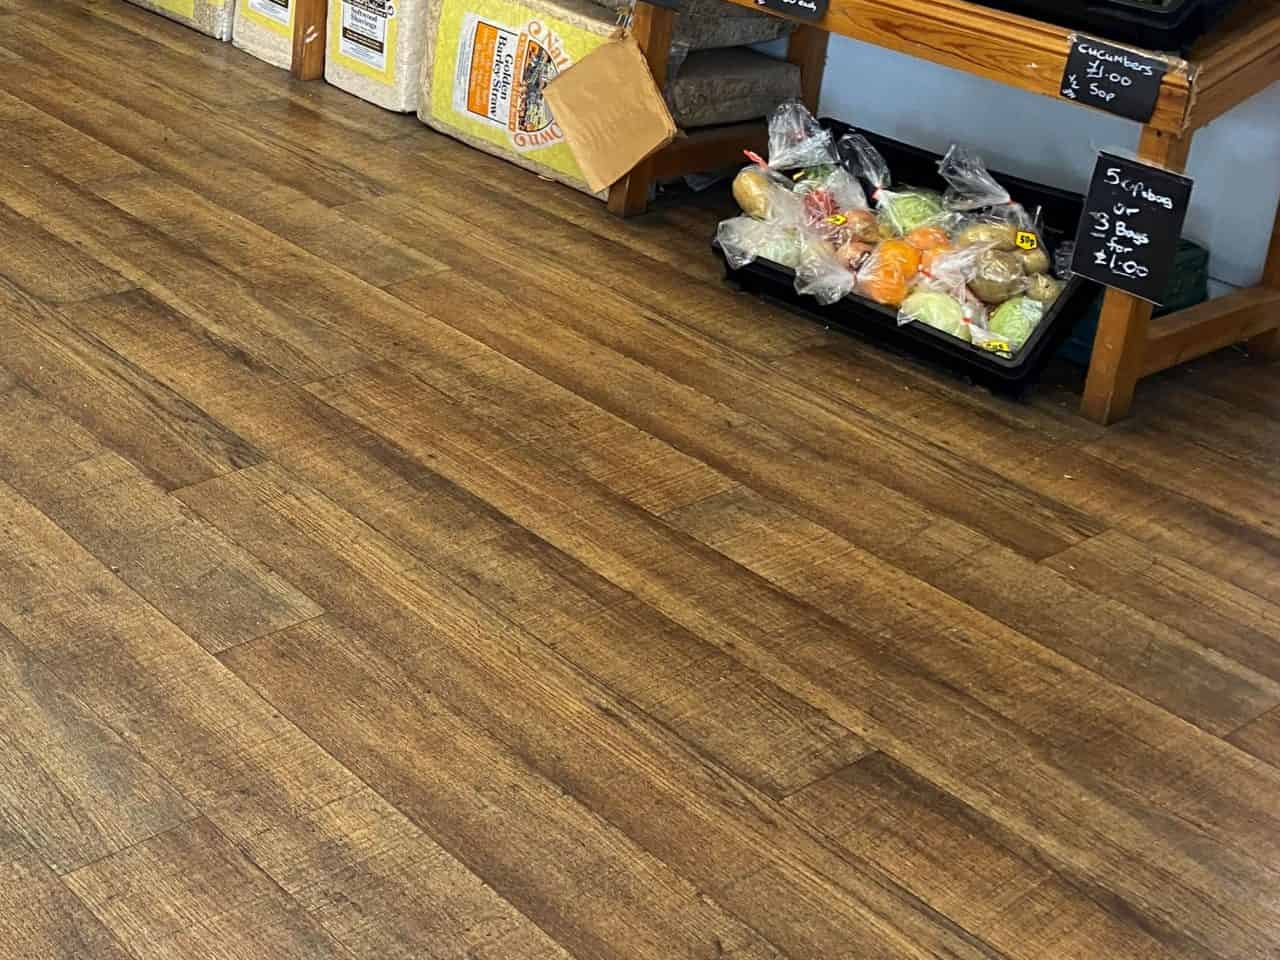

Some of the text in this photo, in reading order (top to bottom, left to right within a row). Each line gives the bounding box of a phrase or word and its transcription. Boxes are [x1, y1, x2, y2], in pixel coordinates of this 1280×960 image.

[490, 36, 507, 117] Barley Straw
[500, 53, 514, 101] Golden
[1113, 202, 1140, 217] or
[1115, 221, 1150, 245] Bags
